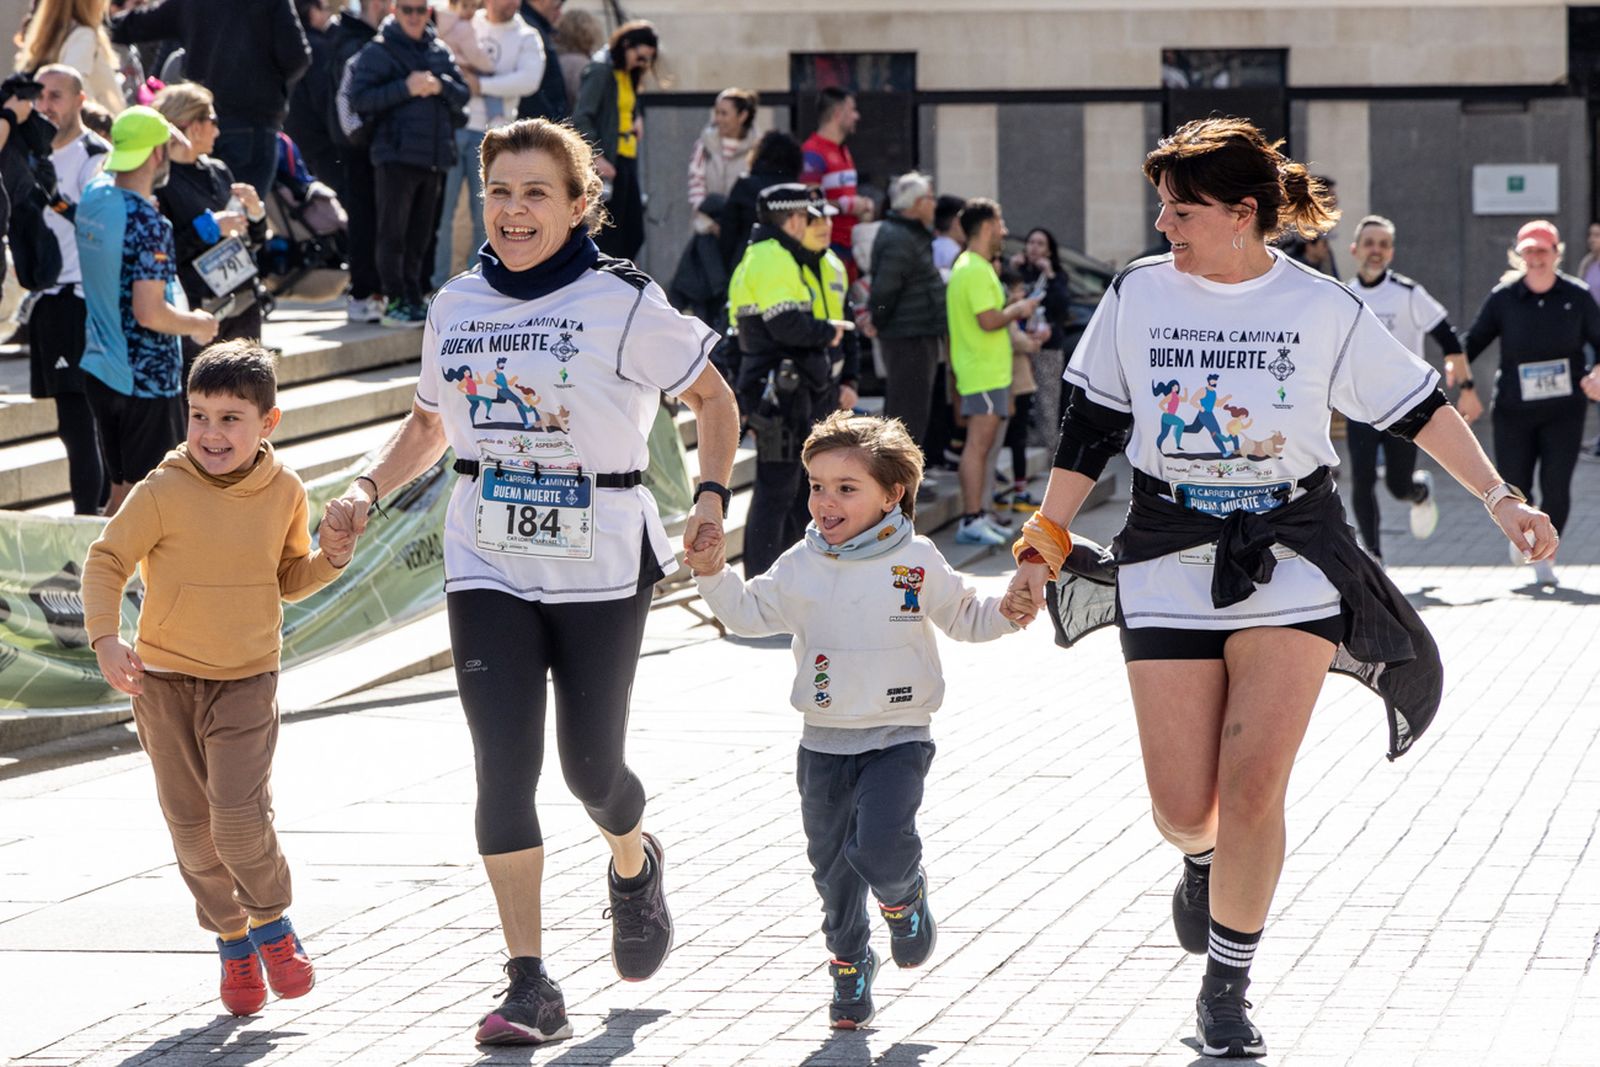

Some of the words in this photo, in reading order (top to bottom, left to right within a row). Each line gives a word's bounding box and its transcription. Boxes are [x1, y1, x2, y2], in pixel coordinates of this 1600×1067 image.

[217, 254, 244, 280] 791
[518, 317, 584, 332] CAMINATA
[1149, 328, 1161, 339] VI
[1163, 328, 1225, 342] CARRERA
[1229, 331, 1300, 344] CAMINATA
[441, 337, 484, 356] BUENA
[489, 333, 550, 352] MUERTE
[1150, 348, 1195, 368] BUENA
[1200, 350, 1267, 369] MUERTE
[504, 474, 537, 485] CARRERA
[539, 478, 580, 488] CAMINATA
[493, 485, 521, 500] BUENA
[524, 488, 561, 503] MUERTE
[1198, 489, 1235, 498] CARRERA
[1238, 487, 1279, 498] CAMINATA
[1221, 496, 1260, 513] MUERTE
[506, 504, 561, 538] 184
[886, 686, 912, 696] SINCE
[884, 911, 903, 919] FILA
[838, 966, 857, 975] FILA
